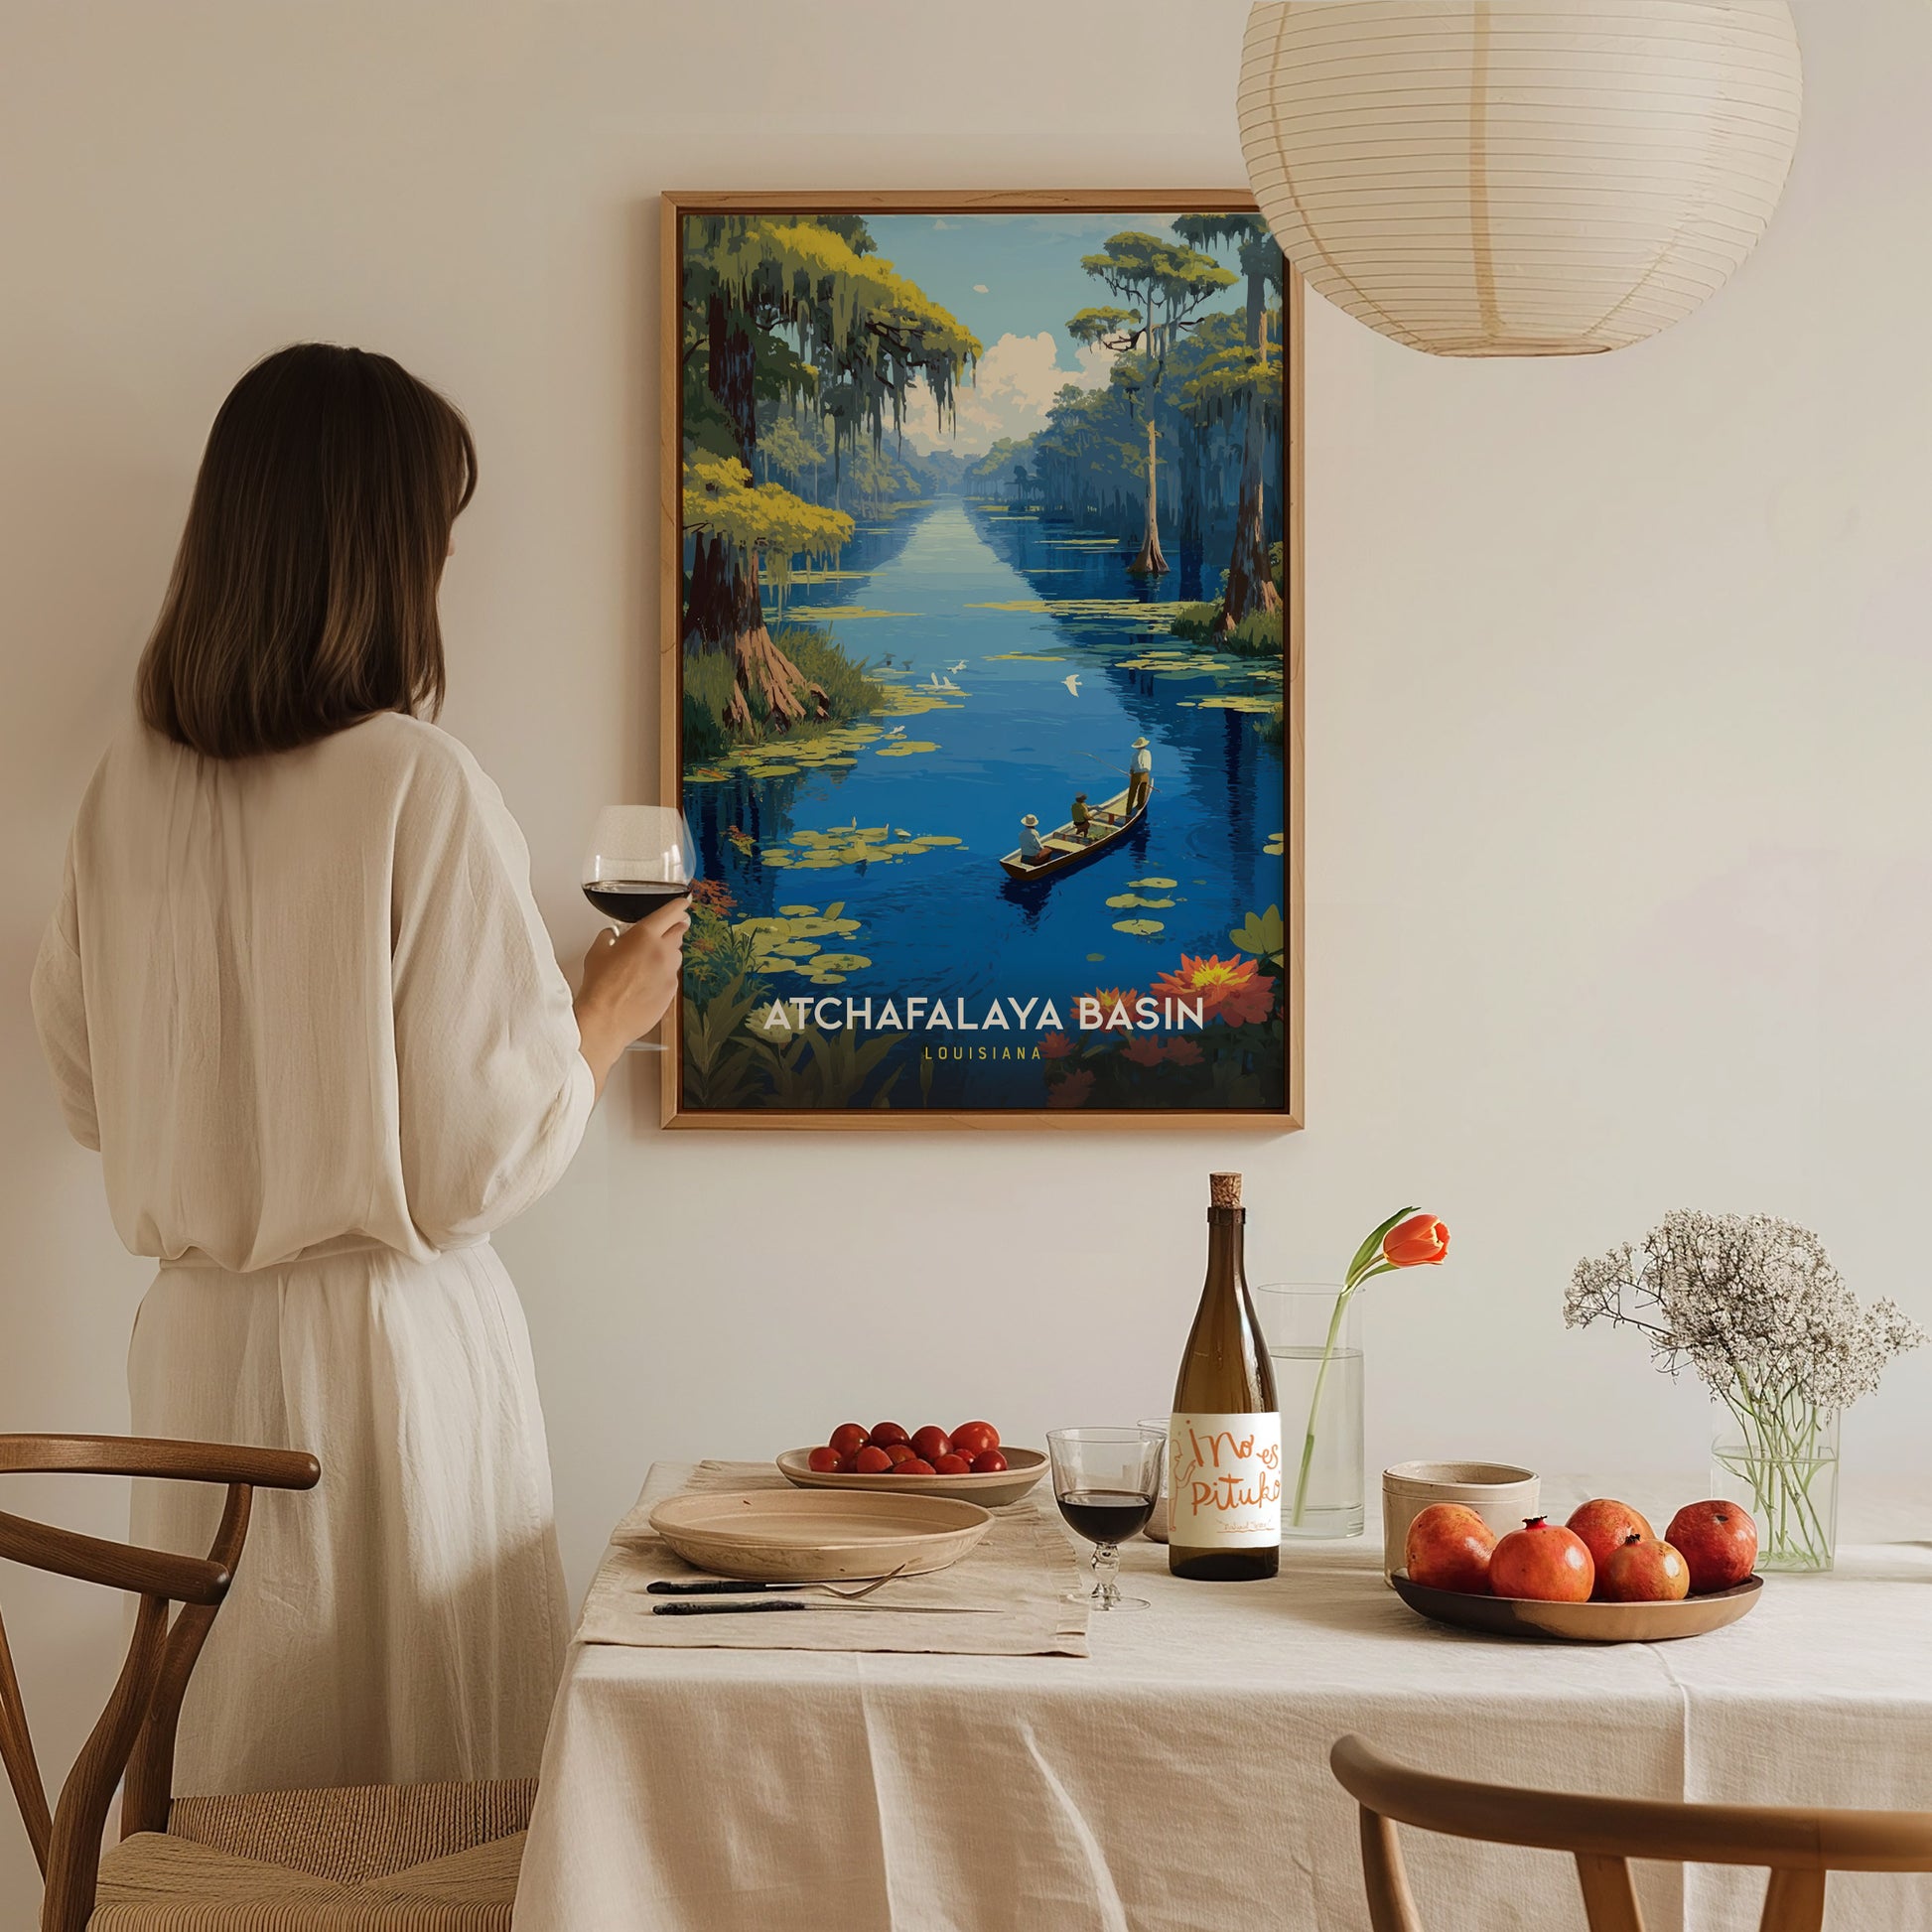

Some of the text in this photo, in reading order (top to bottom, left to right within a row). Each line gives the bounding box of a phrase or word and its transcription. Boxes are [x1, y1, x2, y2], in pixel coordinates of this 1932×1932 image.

[762, 996, 1204, 1031] ATCHAFALAYA BASIN
[923, 1045, 1042, 1060] LOUISIANA
[1256, 1444, 1279, 1470] es
